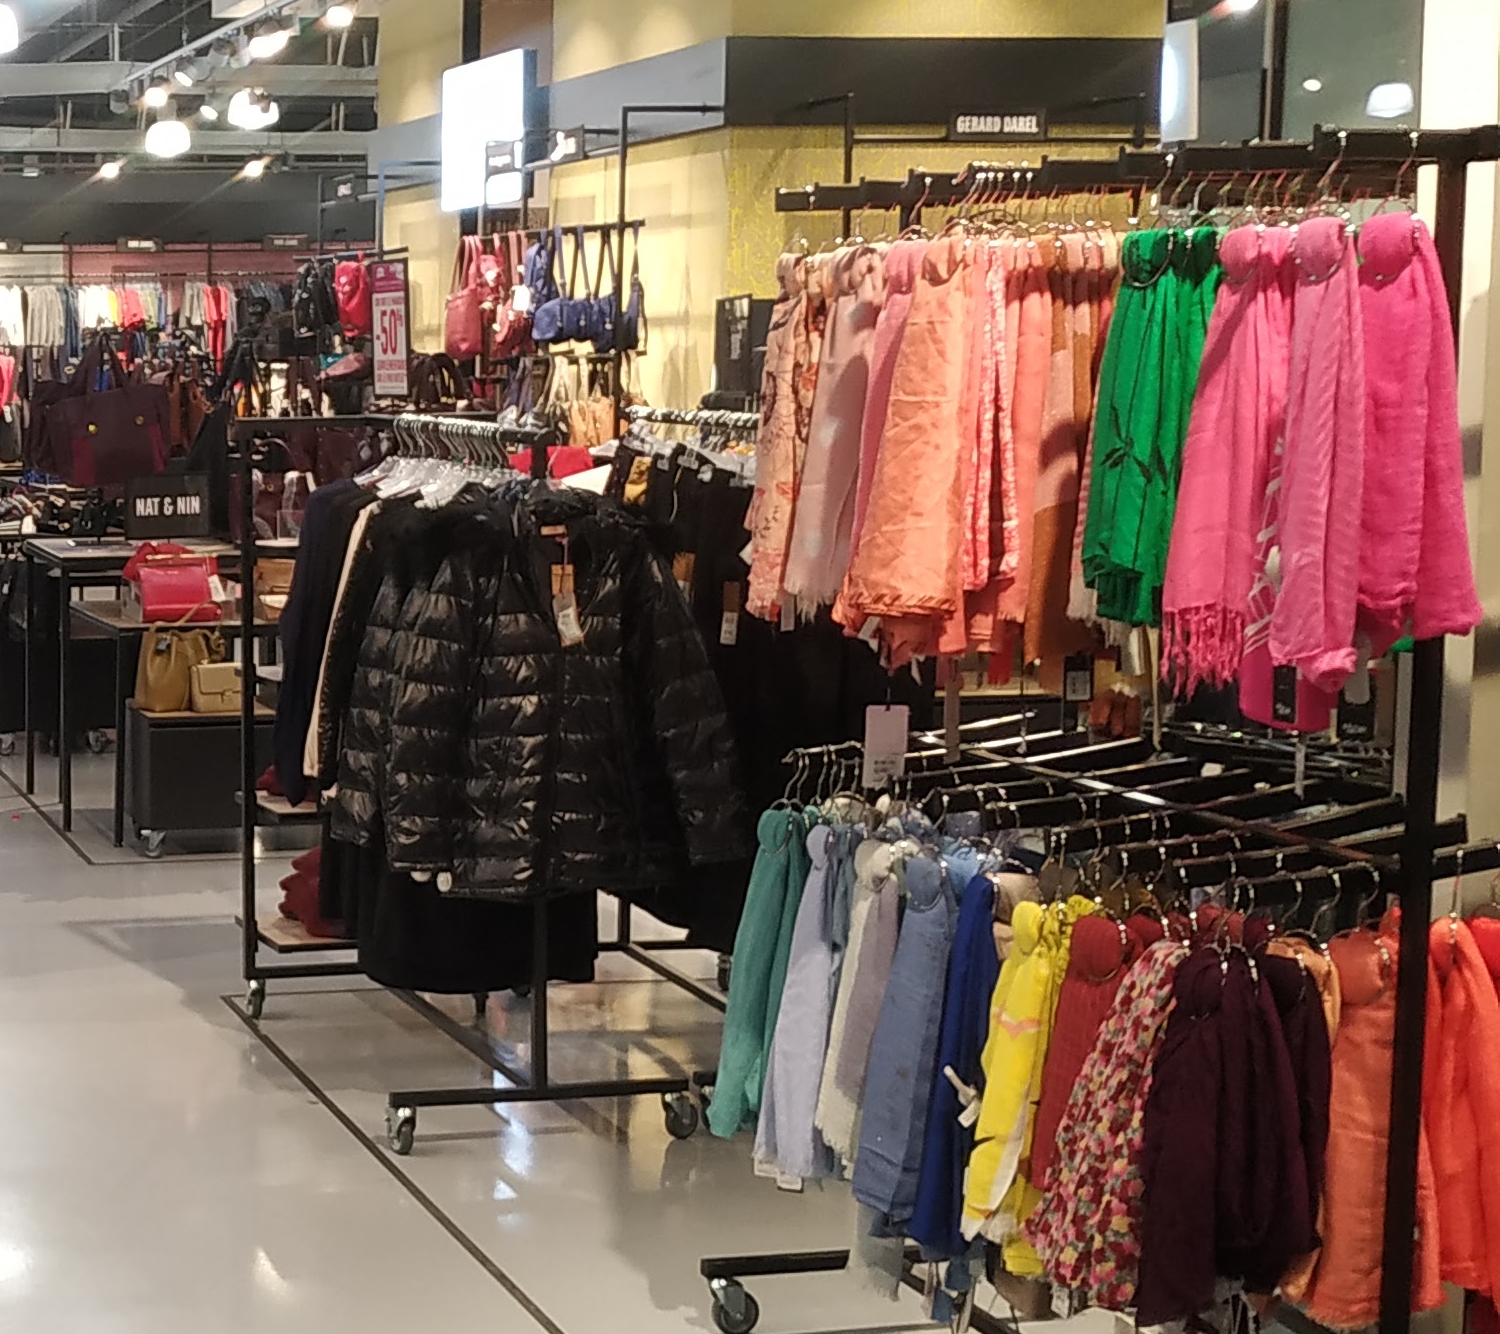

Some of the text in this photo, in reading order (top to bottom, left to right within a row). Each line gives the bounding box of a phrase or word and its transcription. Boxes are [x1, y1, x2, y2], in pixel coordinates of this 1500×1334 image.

[956, 115, 1039, 133] GERARD DAREL
[135, 495, 201, 517] NAT & NIN
